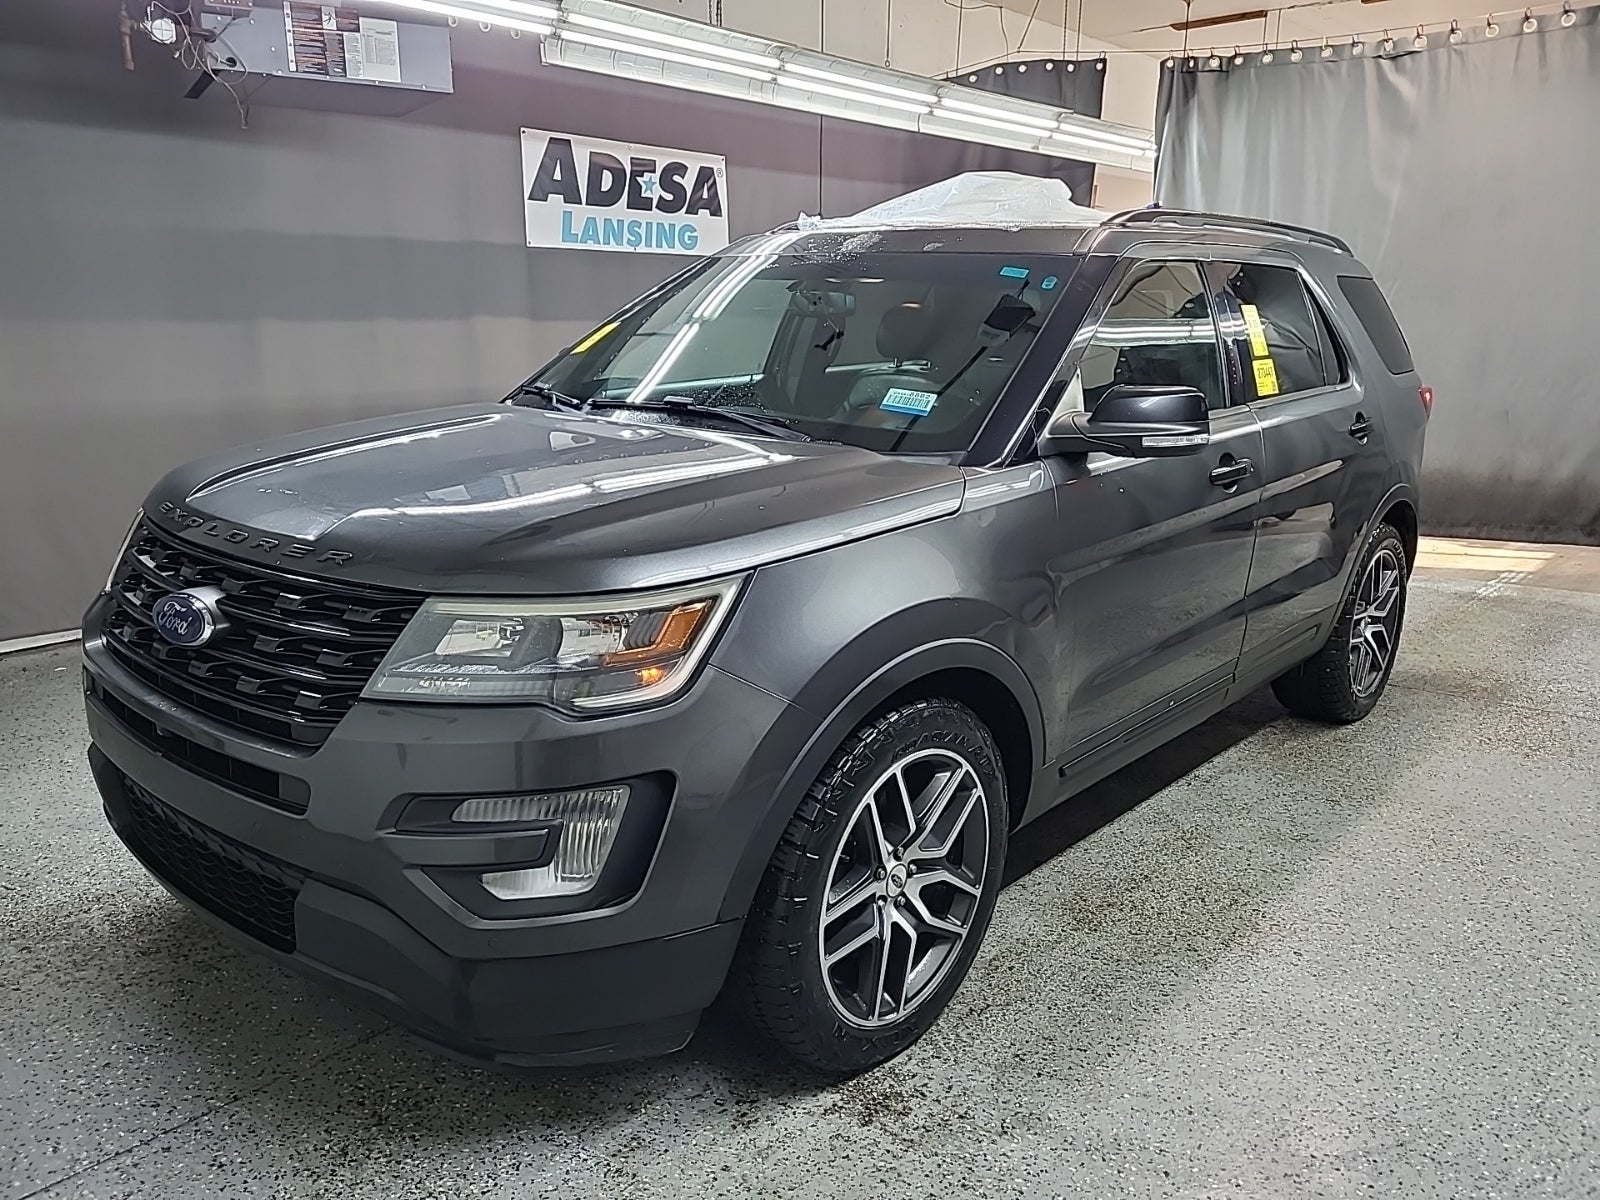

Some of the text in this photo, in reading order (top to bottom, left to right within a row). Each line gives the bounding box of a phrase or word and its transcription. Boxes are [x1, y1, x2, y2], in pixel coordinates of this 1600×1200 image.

[527, 136, 723, 217] ADESA
[561, 210, 699, 251] LANSING
[158, 501, 354, 565] EXPLORER
[158, 601, 193, 635] Ford
